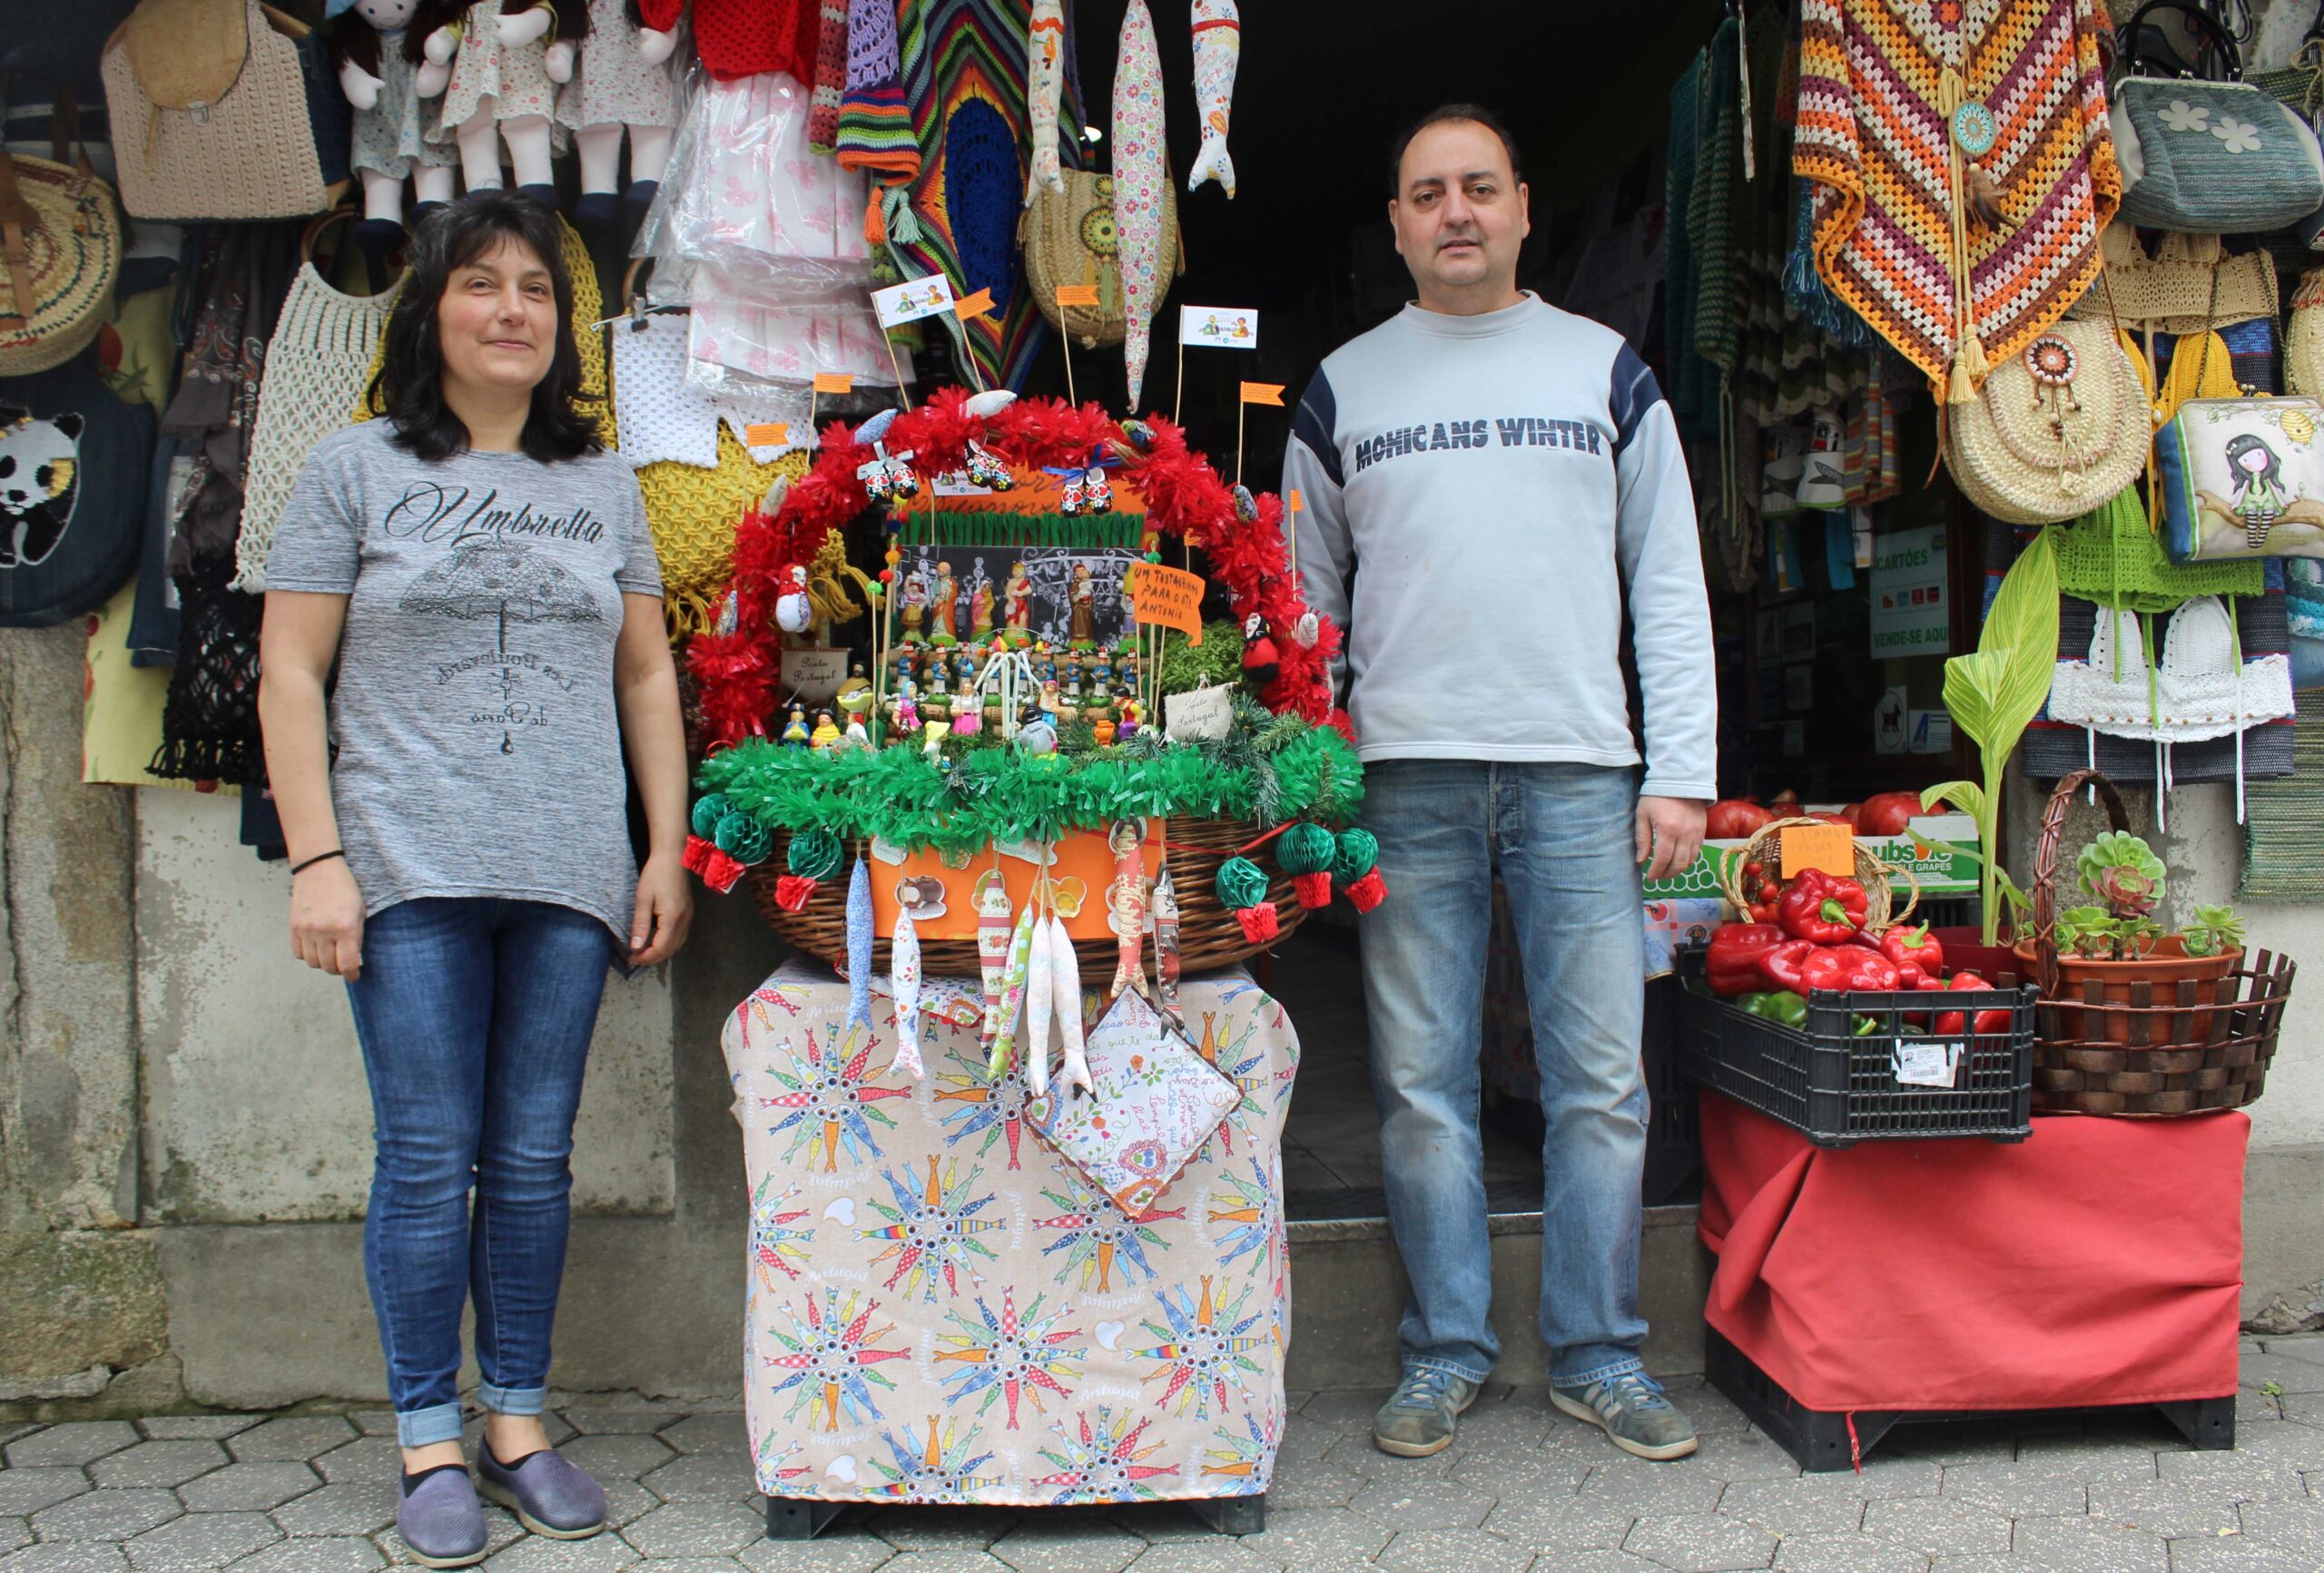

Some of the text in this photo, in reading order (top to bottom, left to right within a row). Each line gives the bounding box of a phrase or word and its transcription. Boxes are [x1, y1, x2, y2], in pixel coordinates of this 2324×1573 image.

[1355, 418, 1601, 473] MOHICANS WINTER
[385, 481, 604, 547] Umbrella
[1877, 547, 1928, 572] CARTÕES
[1134, 567, 1150, 582] UM
[1141, 584, 1170, 602] PARA
[1873, 629, 1922, 647] VENDE-SE
[1915, 862, 1952, 872] GRAPES
[805, 1264, 870, 1288] Portugal
[1081, 1285, 1147, 1310] Portugal
[1077, 1382, 1142, 1407] Portugal
